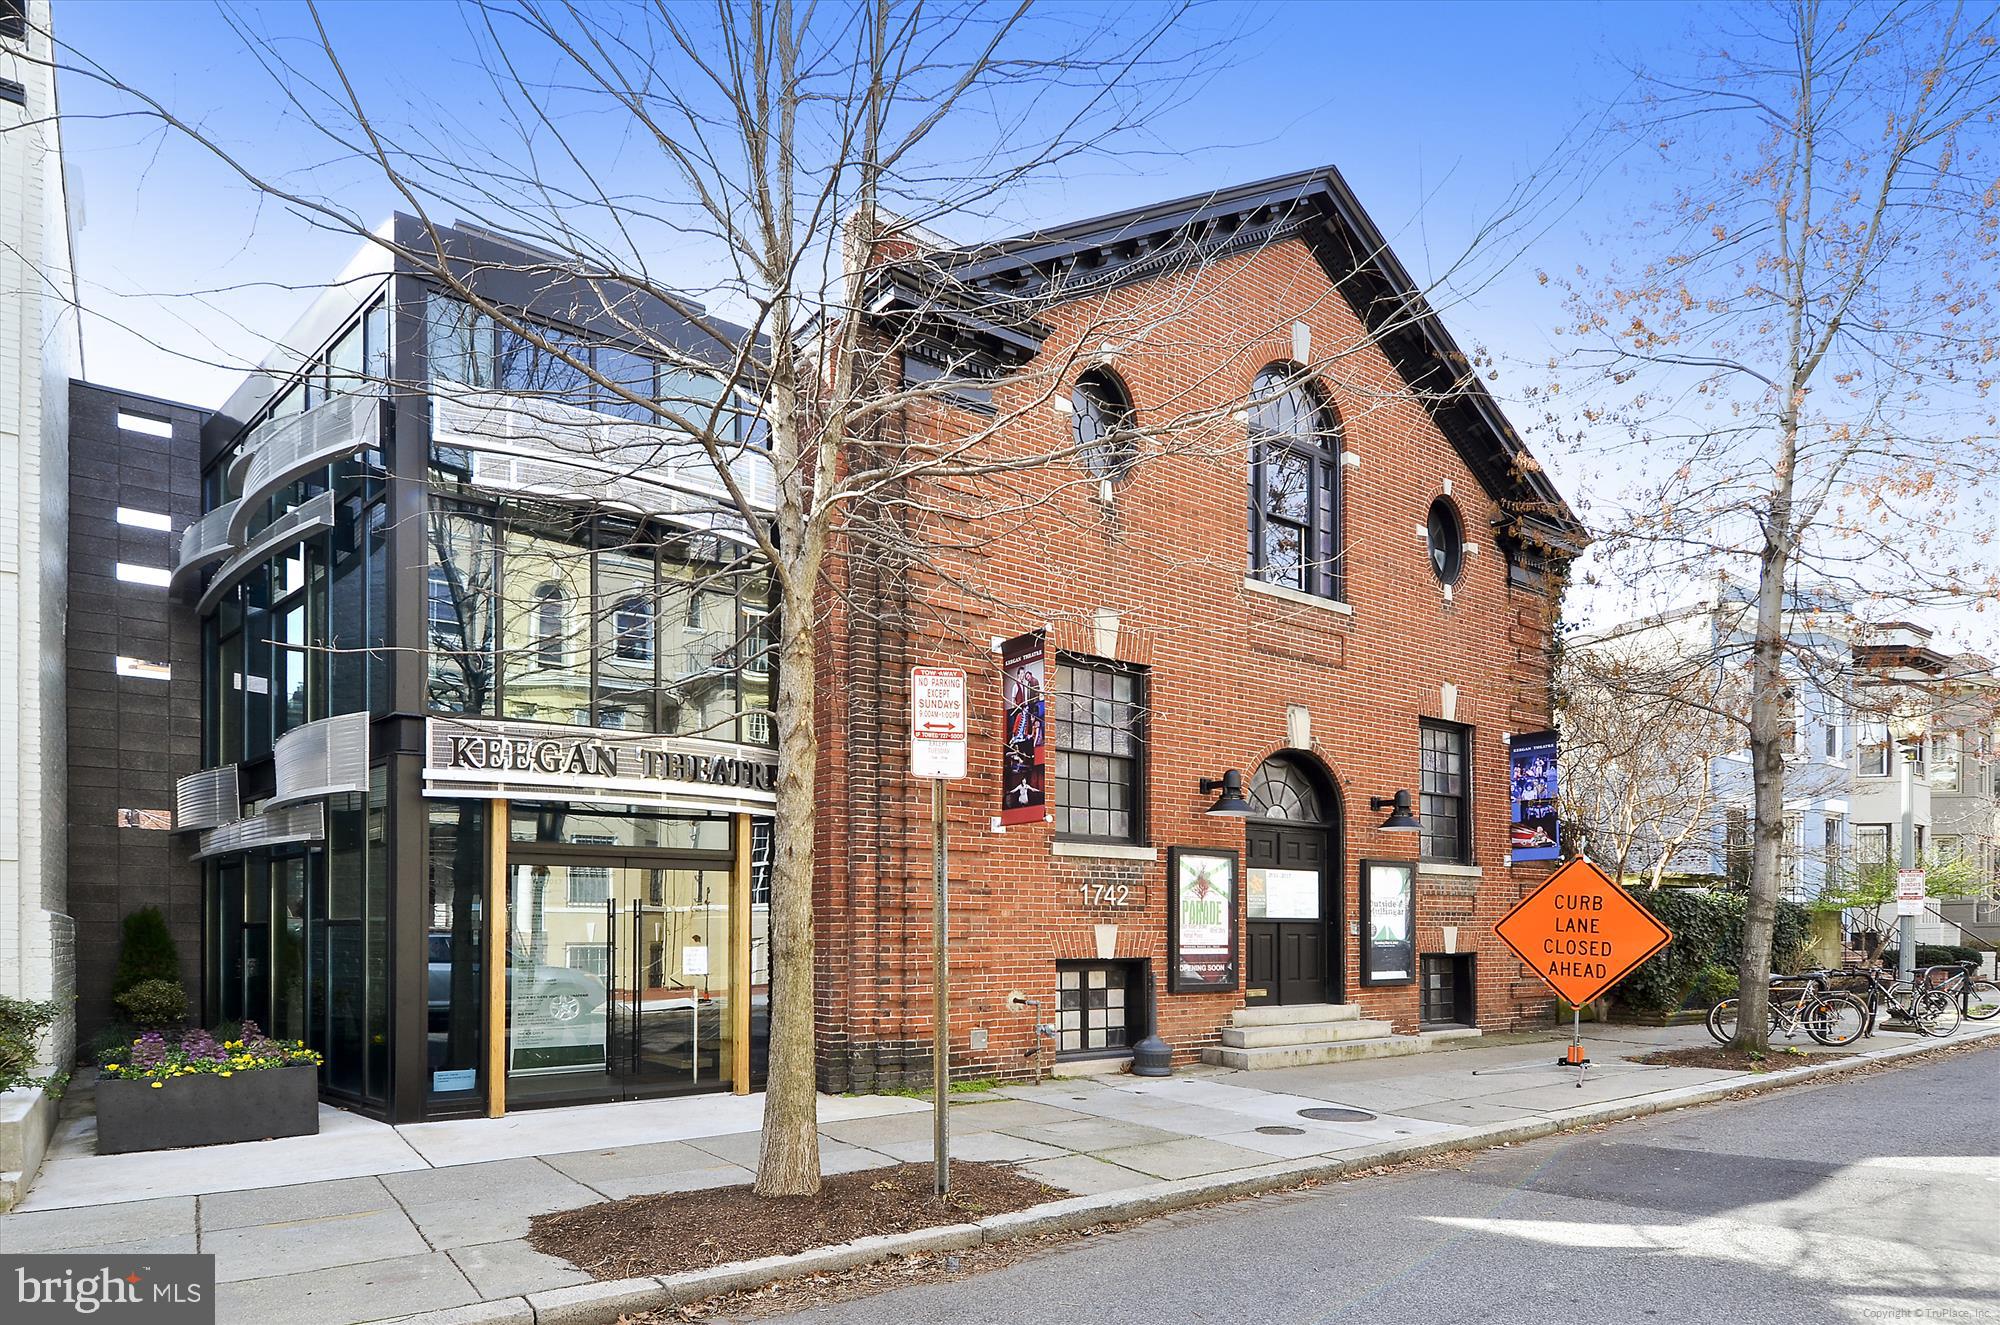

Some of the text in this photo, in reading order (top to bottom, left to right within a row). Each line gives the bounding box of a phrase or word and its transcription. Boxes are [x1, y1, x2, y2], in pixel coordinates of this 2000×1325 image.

[918, 677, 961, 688] NO PARKING
[927, 688, 950, 698] EXCEPT
[919, 699, 960, 709] SUNDAYS
[448, 735, 778, 791] KEEGAN THEATR
[1080, 884, 1129, 905] 1742
[1555, 895, 1603, 911] CURB
[1182, 900, 1222, 925] PARADE
[1556, 918, 1600, 933] LANE
[1544, 939, 1612, 957] CLOSED
[1180, 964, 1207, 972] OPENING
[1549, 961, 1606, 979] AHEAD
